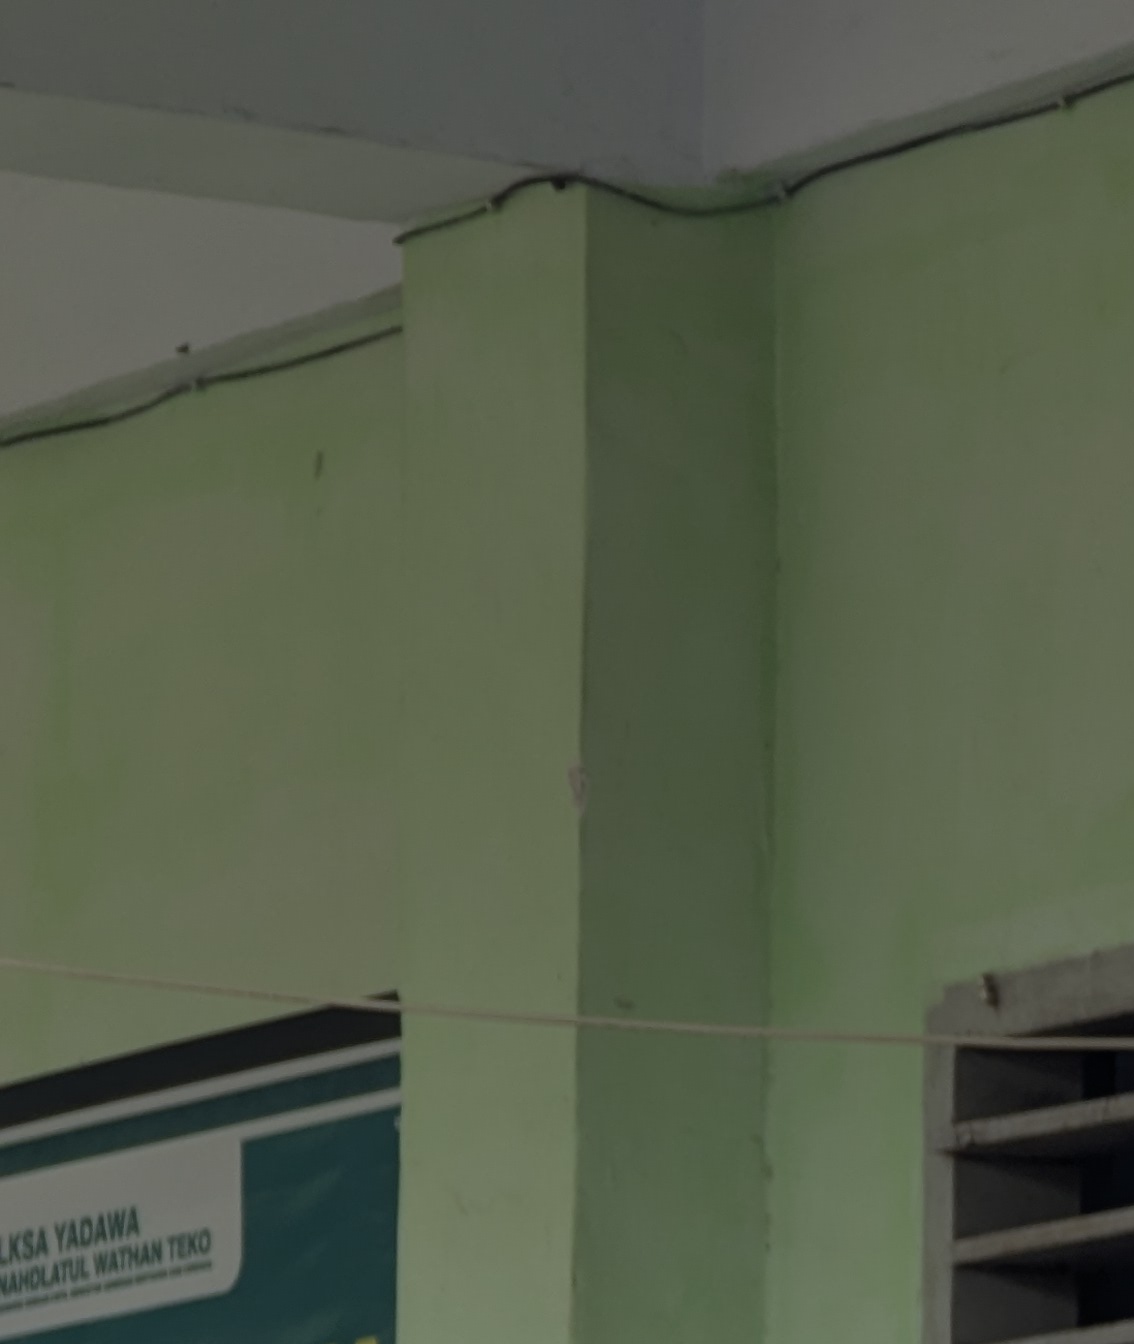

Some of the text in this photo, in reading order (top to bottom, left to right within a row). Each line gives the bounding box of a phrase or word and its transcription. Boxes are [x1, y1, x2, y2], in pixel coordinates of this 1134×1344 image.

[53, 1205, 141, 1253] YADAWA
[93, 1237, 163, 1276] WATHAN
[167, 1226, 213, 1262] TEKO
